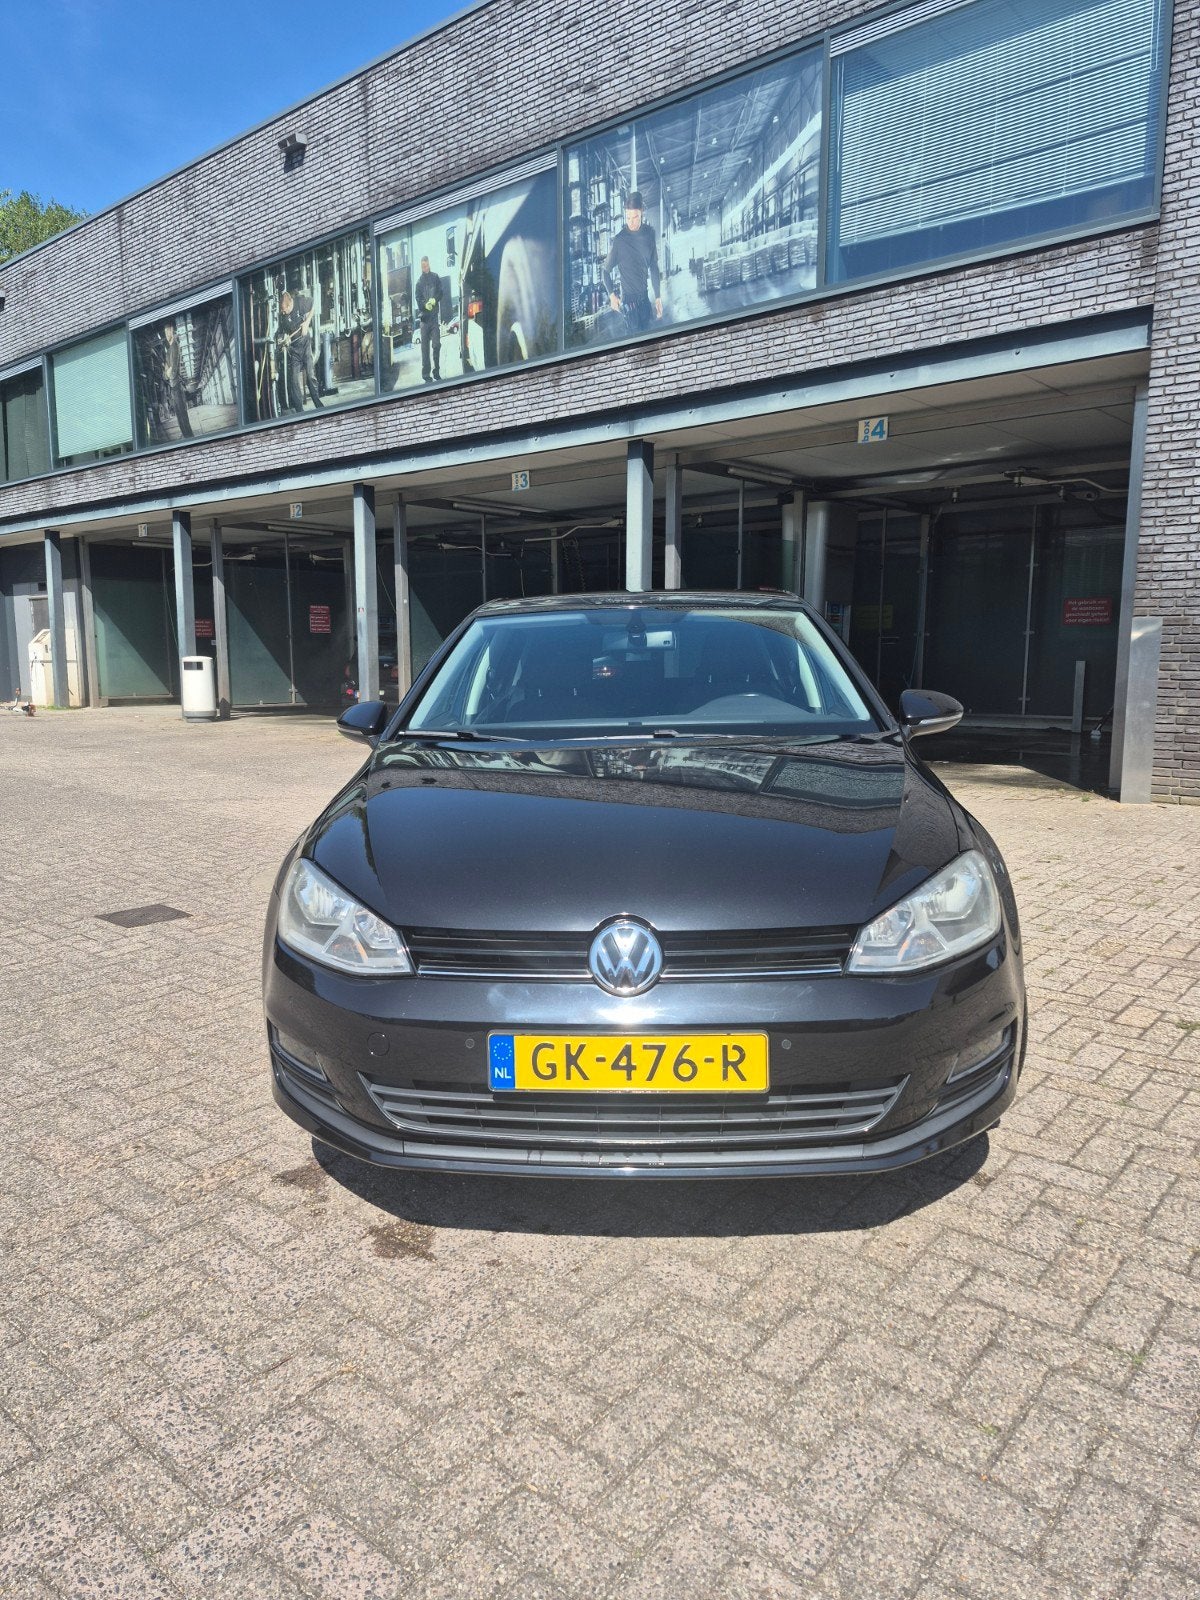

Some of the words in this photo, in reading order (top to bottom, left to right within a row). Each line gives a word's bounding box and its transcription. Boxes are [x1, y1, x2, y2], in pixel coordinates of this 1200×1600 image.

[871, 419, 885, 439] 4
[520, 472, 528, 488] 3
[295, 504, 301, 516] 2
[591, 923, 660, 991] VW
[531, 1042, 747, 1082] GK-476-R
[494, 1067, 512, 1079] NL
